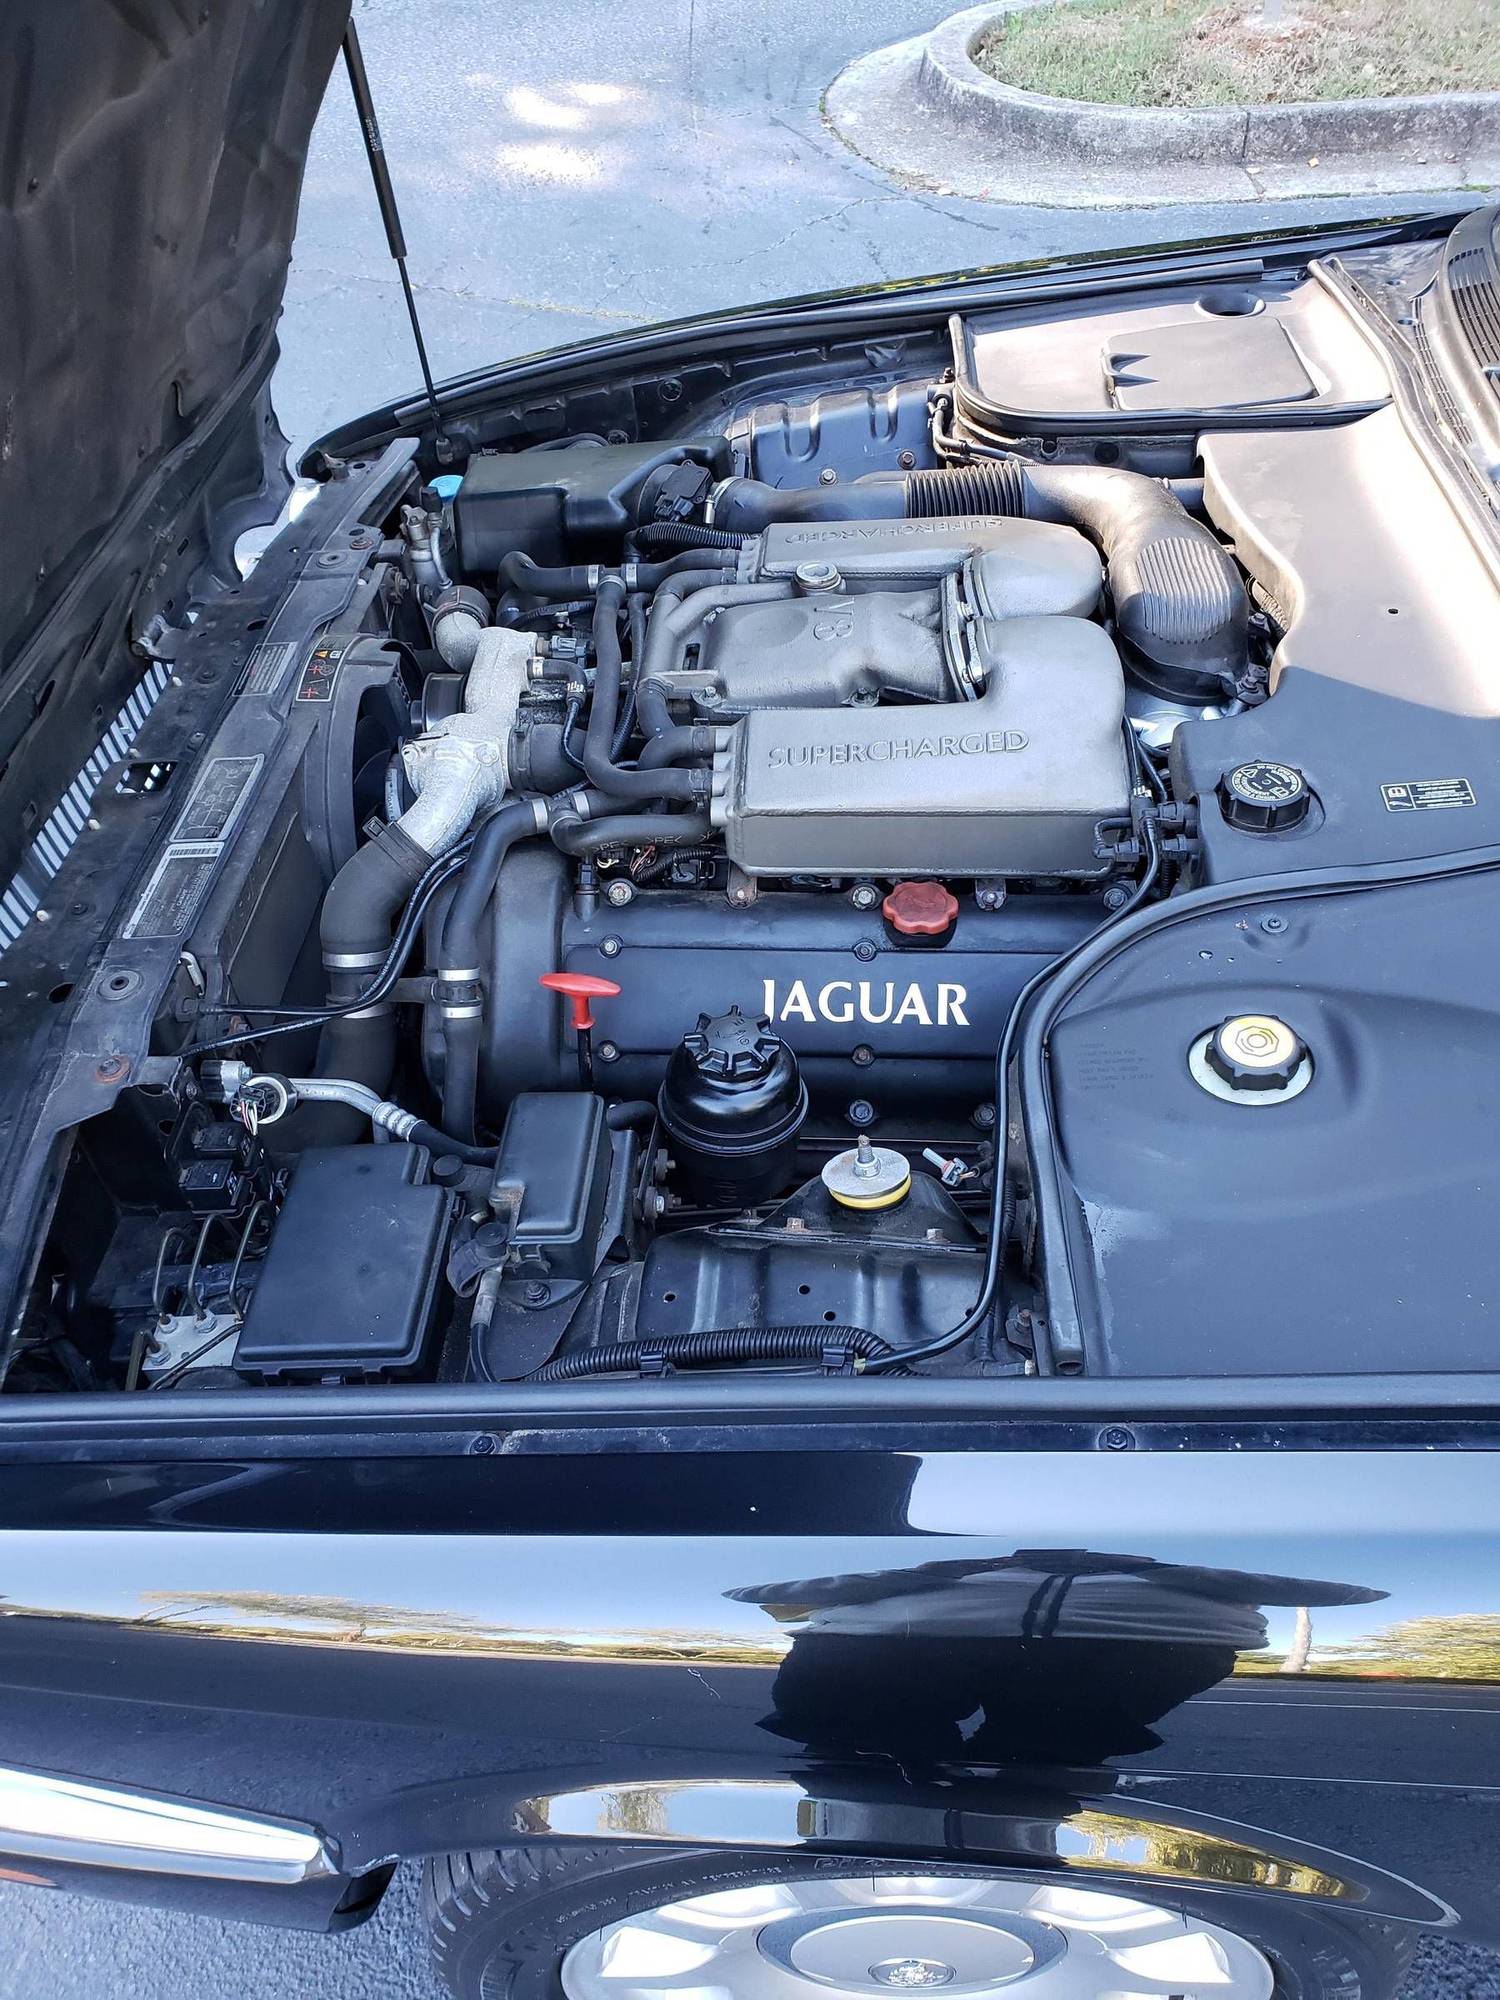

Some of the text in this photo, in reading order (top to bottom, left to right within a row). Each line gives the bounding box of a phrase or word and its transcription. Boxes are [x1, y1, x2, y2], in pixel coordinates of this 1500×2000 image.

[785, 517, 1003, 544] SUPERCHARGED
[814, 597, 854, 641] V8
[768, 729, 1029, 769] SUPERCHARGED
[763, 979, 970, 1026] JAGUAR
